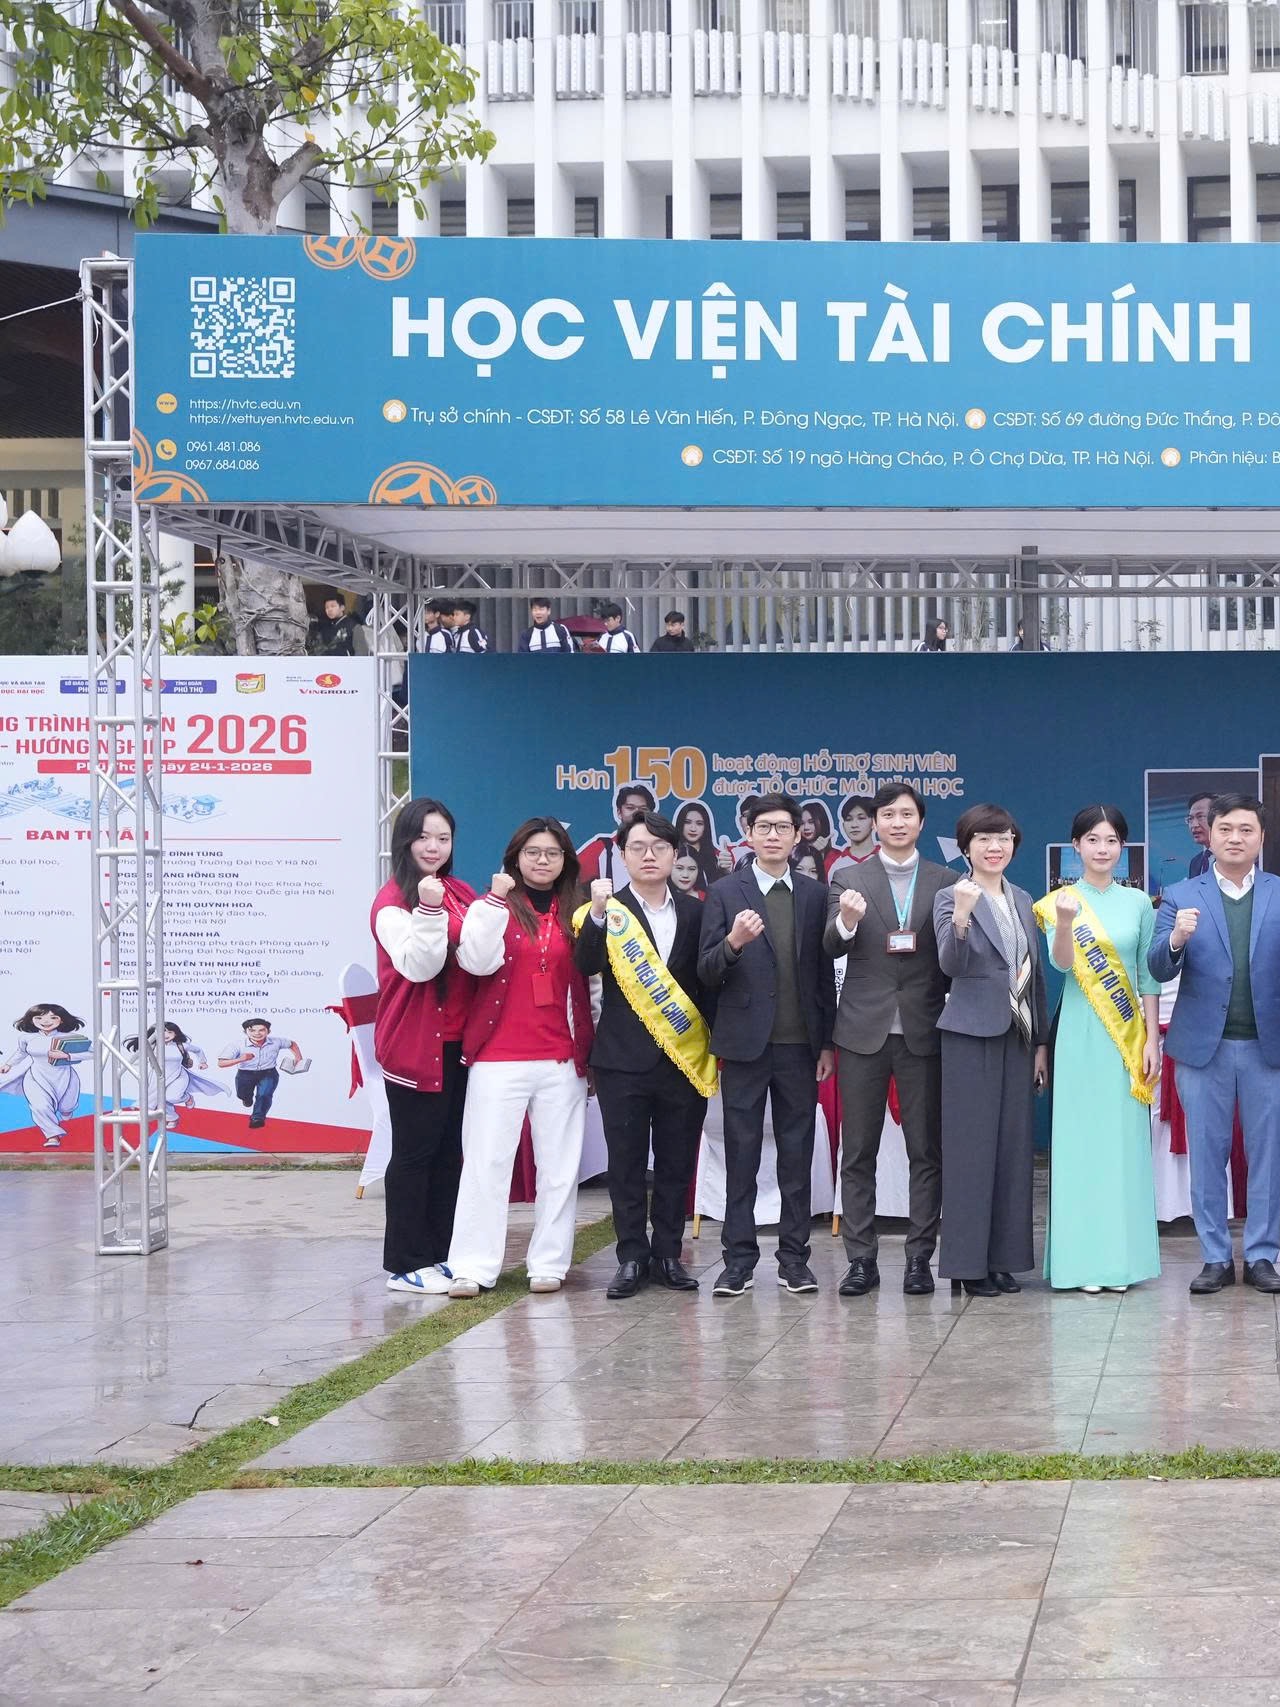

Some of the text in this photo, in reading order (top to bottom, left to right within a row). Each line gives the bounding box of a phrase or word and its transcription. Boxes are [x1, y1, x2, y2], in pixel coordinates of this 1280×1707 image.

[392, 282, 1250, 379] HỌC VIỆN TÀI CHÍNH
[189, 398, 302, 412] https://hvtc.edu.vn
[189, 413, 355, 426] https://xettuyen.hvtc.edu.vn
[410, 405, 959, 431] Trụ sở chính CSĐT: Số 58 Lê Văn Hiến, P. Đông Ngạc, TP. Hà Nội.
[992, 411, 1037, 427] CSĐT:
[1041, 410, 1062, 427] Số
[1064, 411, 1085, 427] 69
[1087, 411, 1142, 430] đường
[1145, 411, 1180, 426] Đức
[1183, 409, 1237, 430] Thắng,
[1242, 411, 1253, 426] P.
[186, 440, 261, 453] 0961.481.086
[185, 459, 260, 471] 0967.684.086
[712, 447, 1155, 470] CSĐT: Số 19 ngõ Hàng Cháo, P. Ô Chợ Dừa, TP. Hà Nội.
[1189, 450, 1228, 464] Phân
[1231, 450, 1268, 467] hiệu:
[26, 714, 90, 732] TRÌNH
[187, 714, 307, 754] 2026
[16, 736, 89, 754] HƯỚNG
[190, 762, 273, 772] 24-1-2026
[712, 749, 956, 775] hoạt động HỖ TRỢ SINH VIÊN
[556, 746, 707, 800] Hơn 150
[785, 775, 837, 796] CHỨC
[923, 777, 964, 799] HỌC
[27, 830, 69, 841] BAN
[1073, 923, 1135, 1023] HỌC VIỆN TÀI CHÍNH
[621, 938, 692, 1036] HỌC VIỆN TÀI CHÍNH
